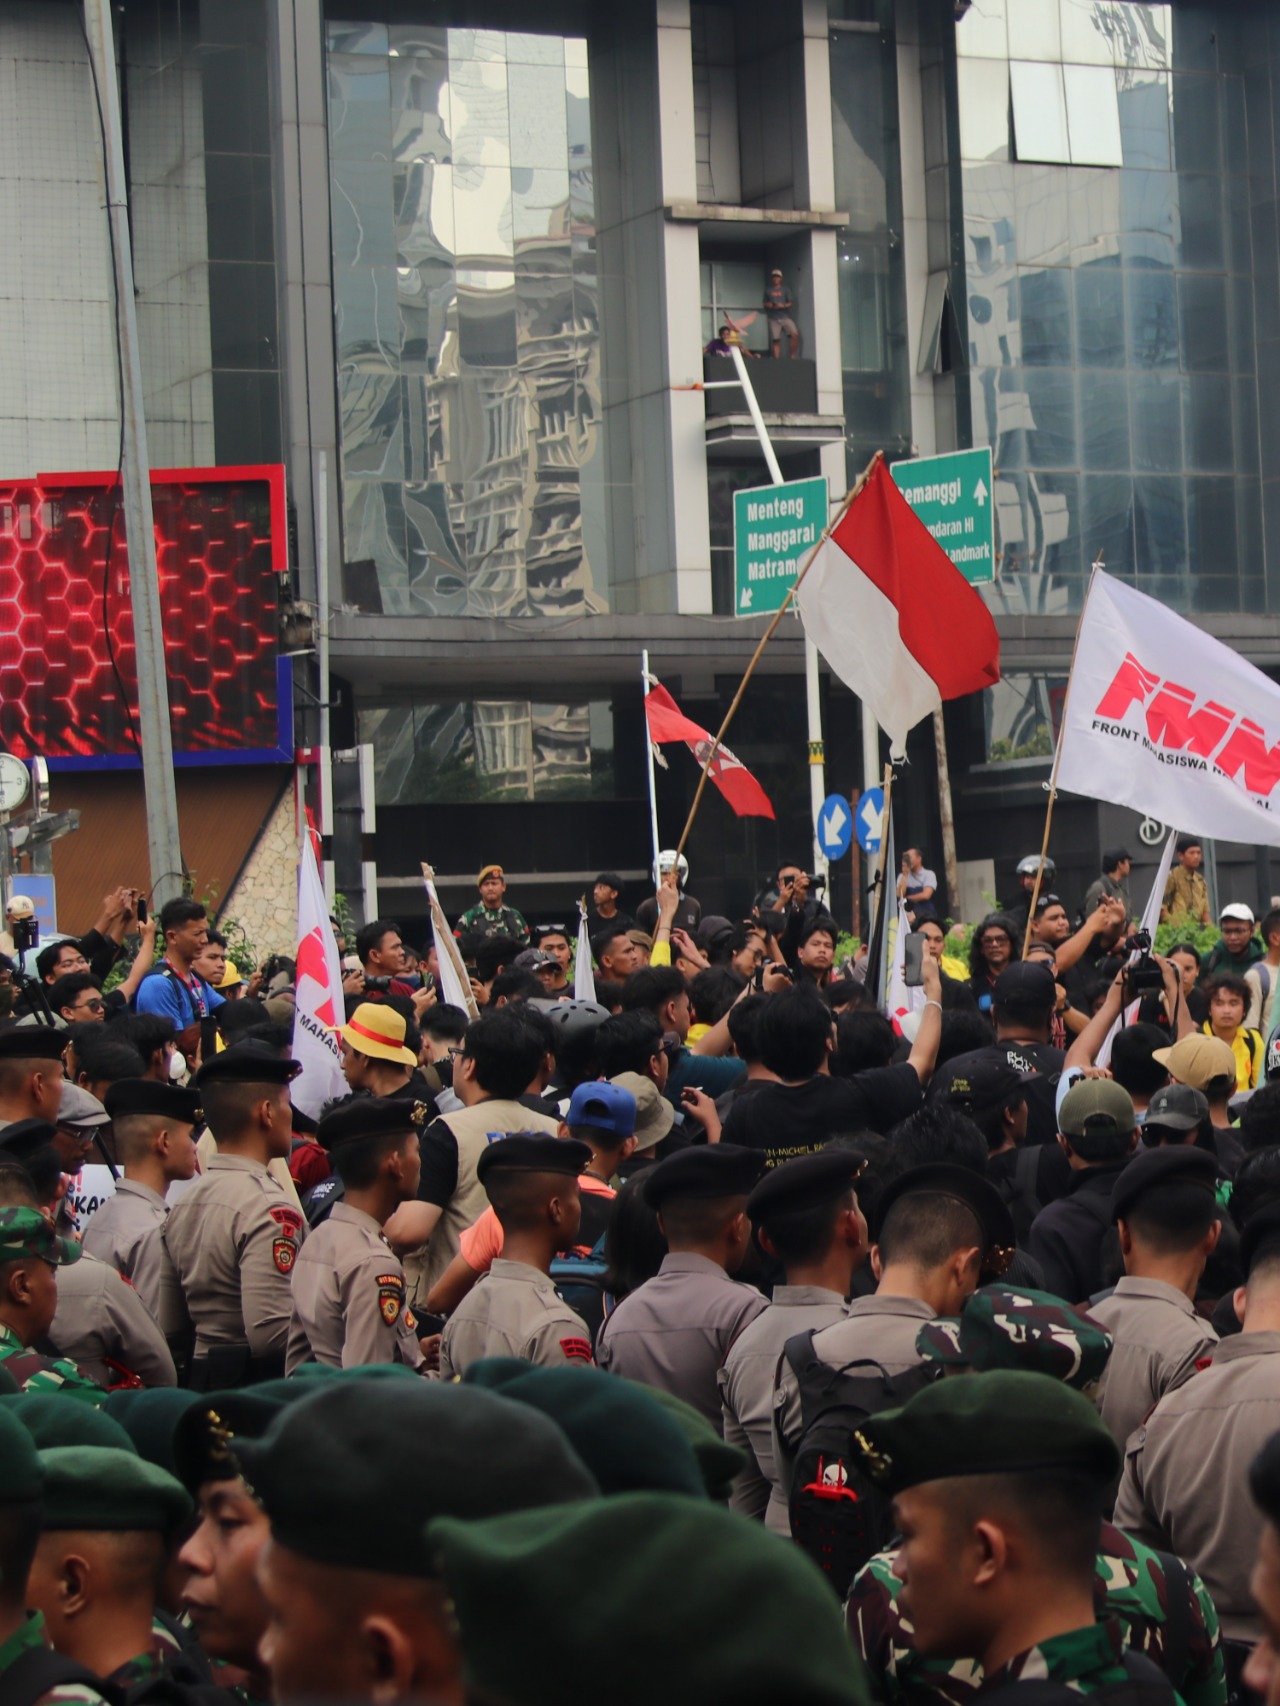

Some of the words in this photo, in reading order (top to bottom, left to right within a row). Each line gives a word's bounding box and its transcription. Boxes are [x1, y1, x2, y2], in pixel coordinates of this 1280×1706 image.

[747, 497, 804, 522] Menteng
[964, 516, 974, 534] HI
[747, 523, 815, 553] Manggarai
[748, 558, 798, 581] Matram
[1092, 720, 1140, 742] FRONT
